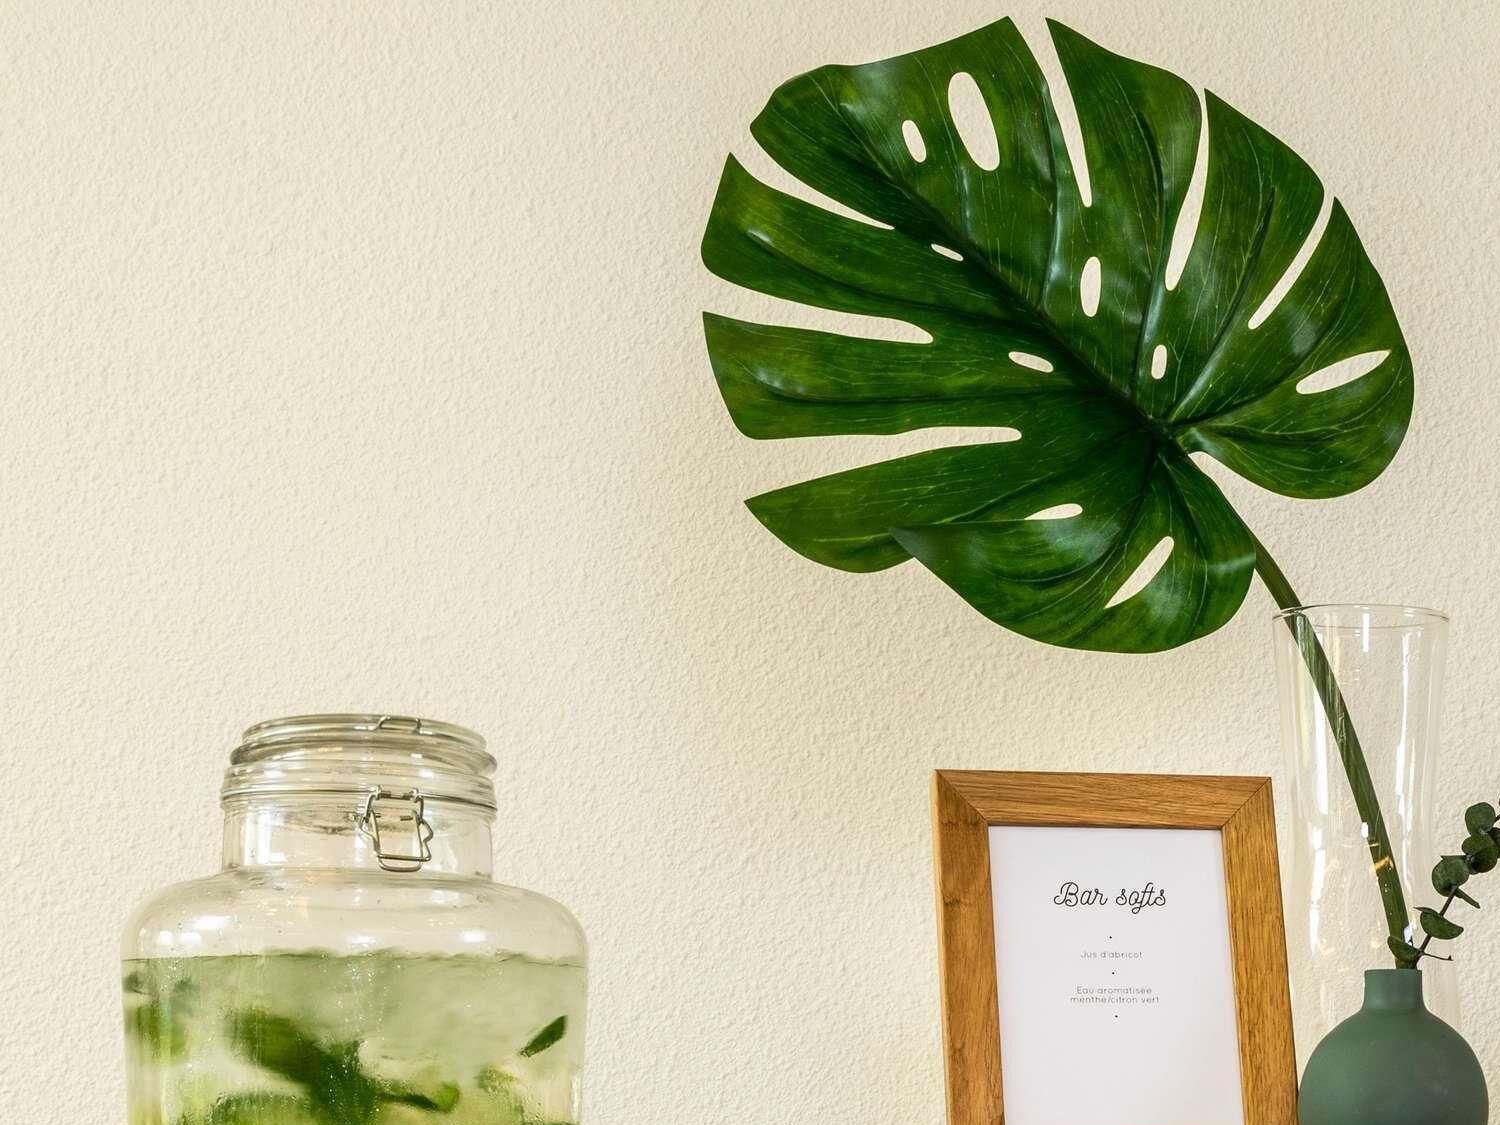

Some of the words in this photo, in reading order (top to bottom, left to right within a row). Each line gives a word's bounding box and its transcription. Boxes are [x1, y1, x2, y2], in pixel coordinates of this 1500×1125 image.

[1053, 881, 1108, 907] Bar
[1115, 881, 1167, 915] softs
[1080, 951, 1097, 959] Jus
[1076, 986, 1094, 995] Eau
[1141, 996, 1159, 1004] vert
